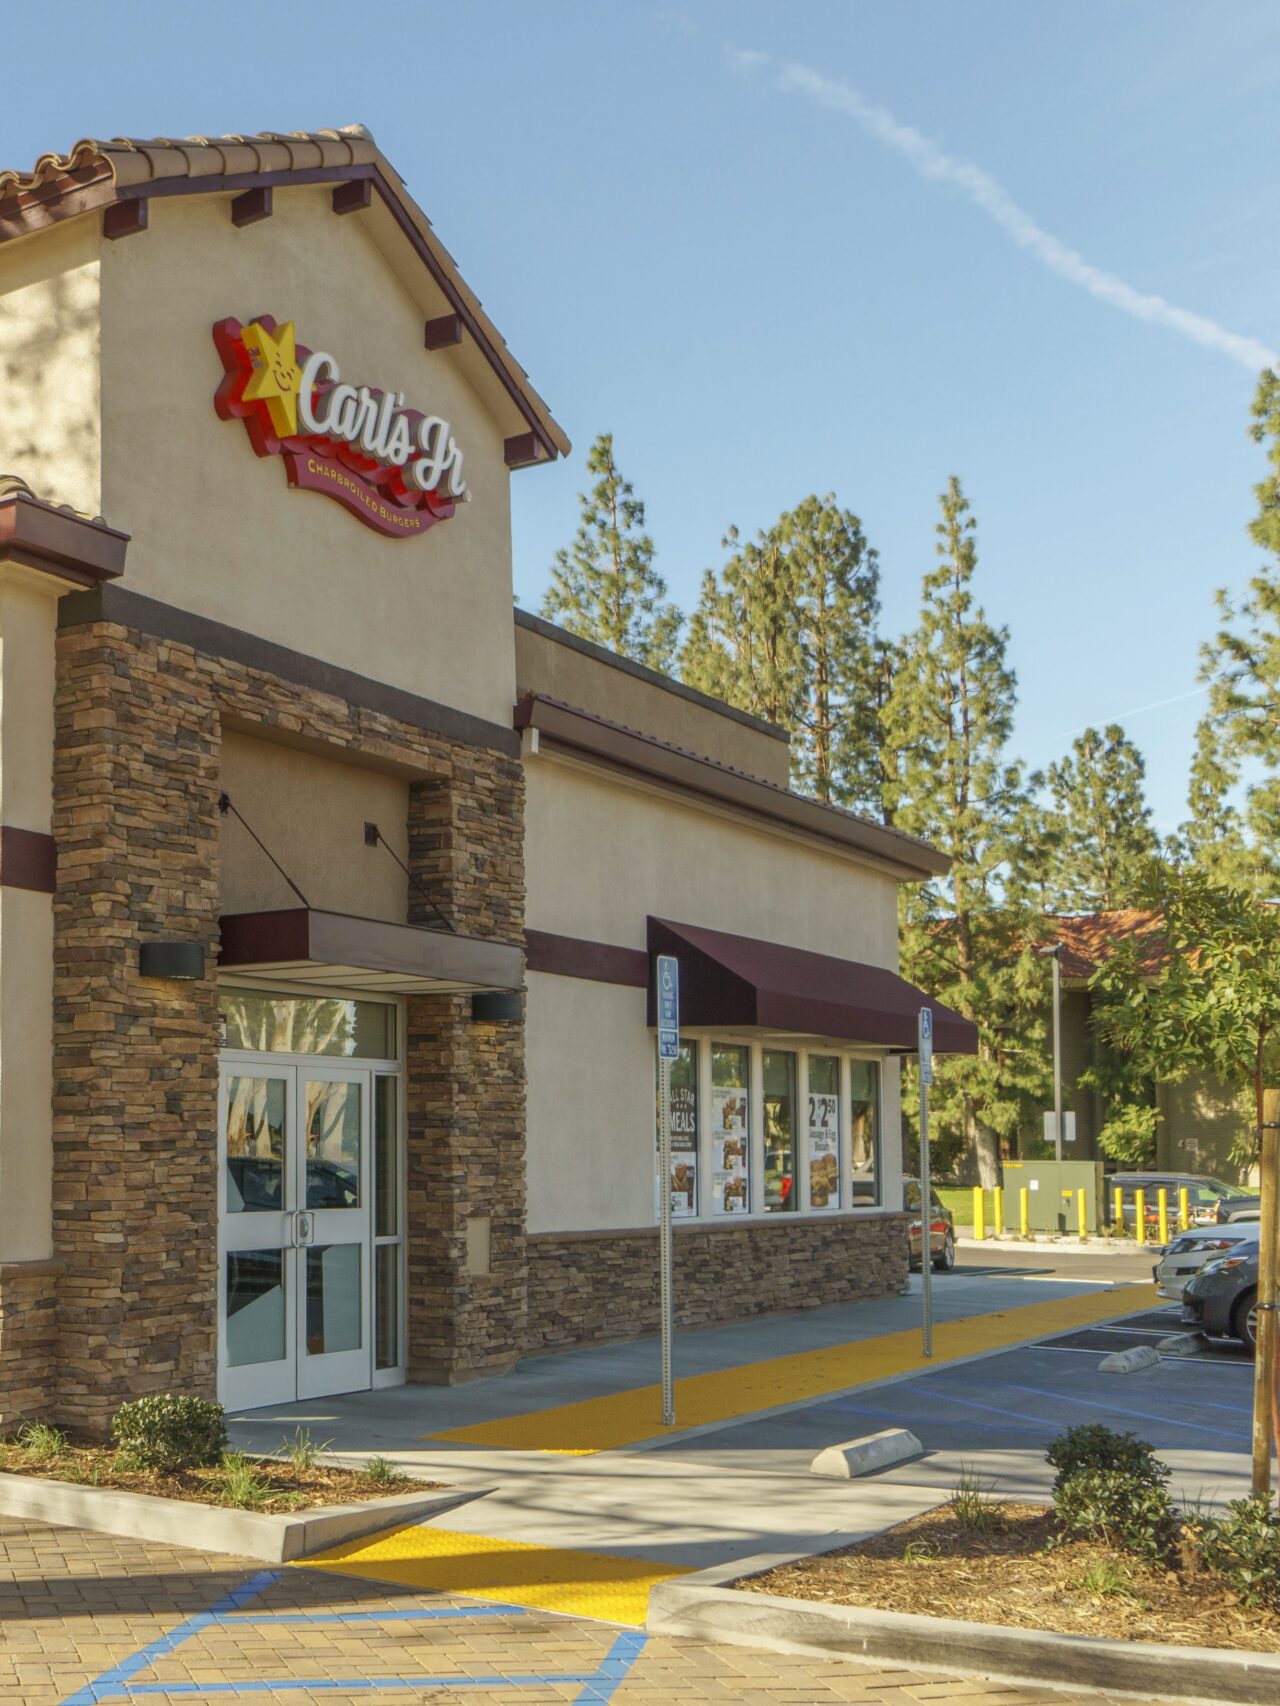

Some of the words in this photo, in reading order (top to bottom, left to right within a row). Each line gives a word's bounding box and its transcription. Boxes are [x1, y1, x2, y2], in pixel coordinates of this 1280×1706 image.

[300, 352, 415, 466] Carl's
[416, 417, 471, 502] Jr.
[308, 458, 378, 513] CHARBROILED
[379, 506, 421, 528] BURGERS
[670, 1111, 696, 1133] MEALS
